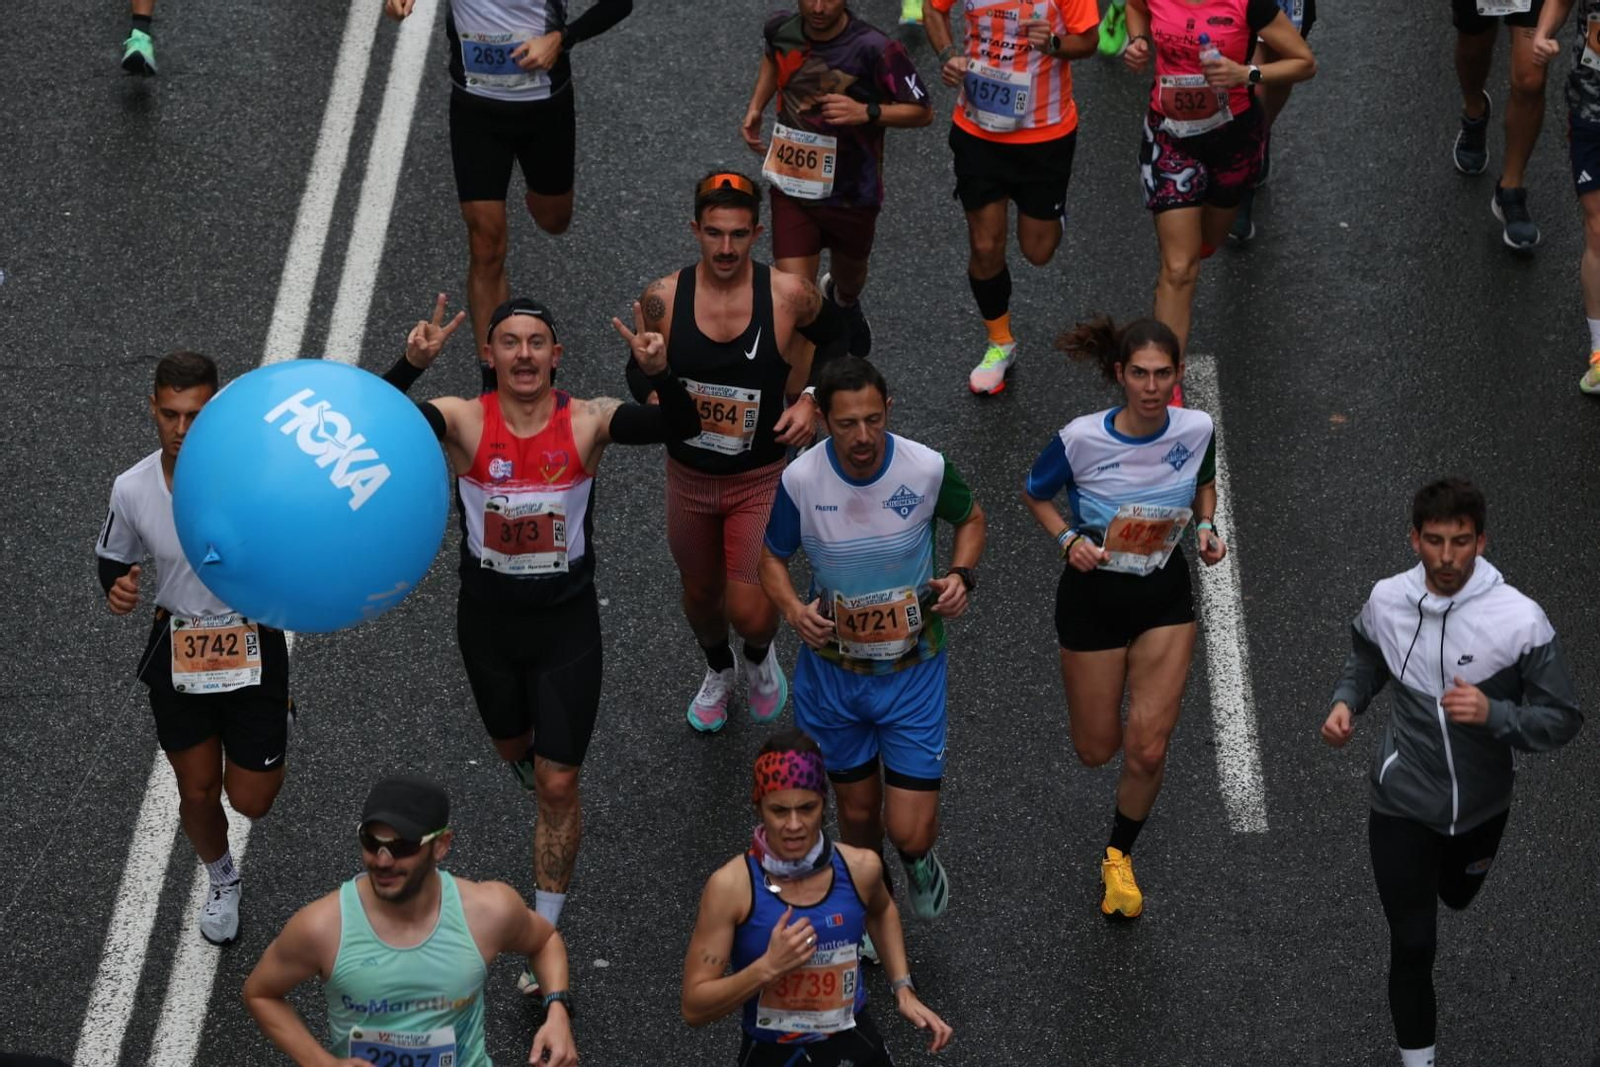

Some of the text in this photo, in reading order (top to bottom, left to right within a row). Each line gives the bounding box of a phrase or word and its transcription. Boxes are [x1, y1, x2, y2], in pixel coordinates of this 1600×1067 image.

[971, 79, 1011, 105] 1573
[1174, 92, 1206, 111] 532
[776, 143, 818, 169] 4266
[263, 388, 391, 511] HOKA
[501, 521, 539, 545] 373
[846, 607, 898, 633] 4721
[184, 633, 239, 658] 3742
[818, 939, 850, 951] antes
[775, 971, 836, 998] 3739
[366, 1047, 431, 1067] 2297
